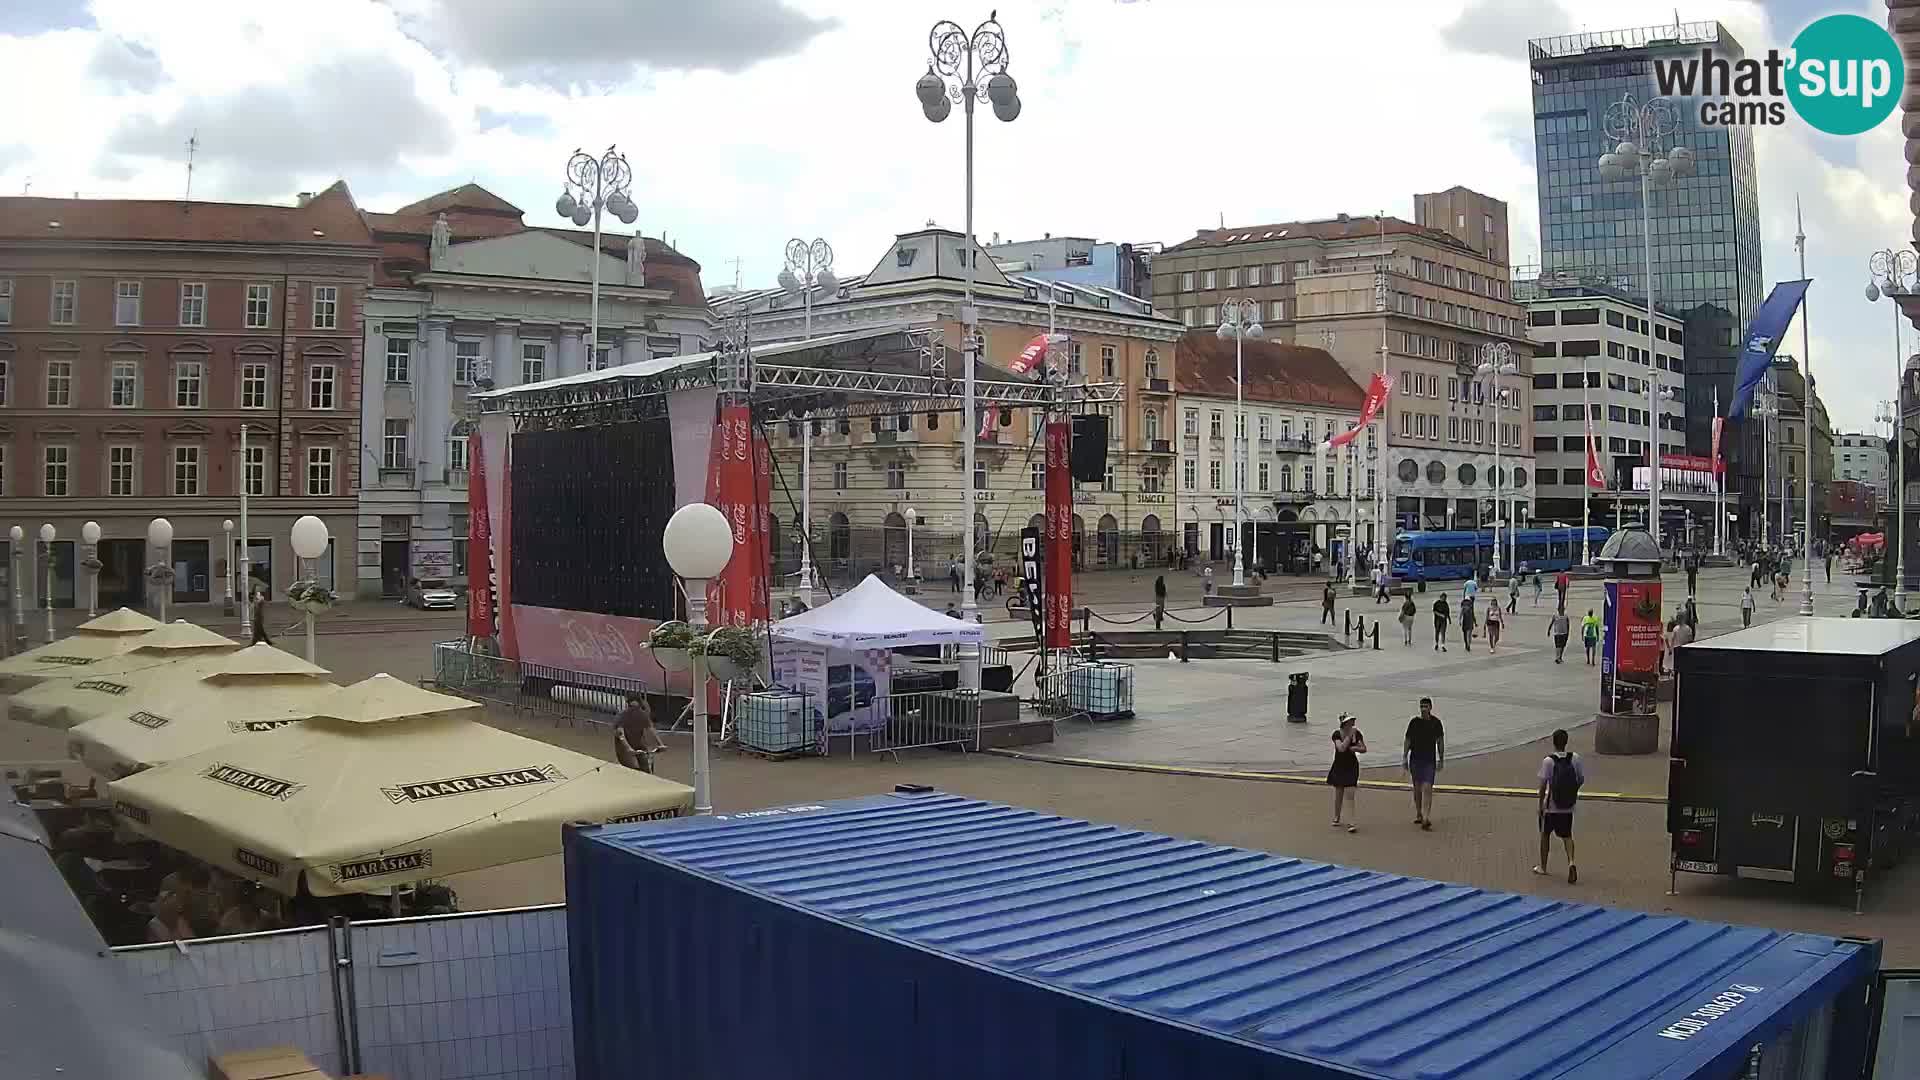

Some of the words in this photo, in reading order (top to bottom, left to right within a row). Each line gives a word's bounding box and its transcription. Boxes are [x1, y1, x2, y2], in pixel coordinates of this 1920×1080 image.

[960, 491, 995, 501] SGER
[216, 766, 287, 797] MARASKA
[412, 771, 541, 799] MARASKA
[344, 855, 418, 879] MARASKA
[1657, 1017, 1709, 1040] MCDU
[1691, 990, 1747, 1020] 300629
